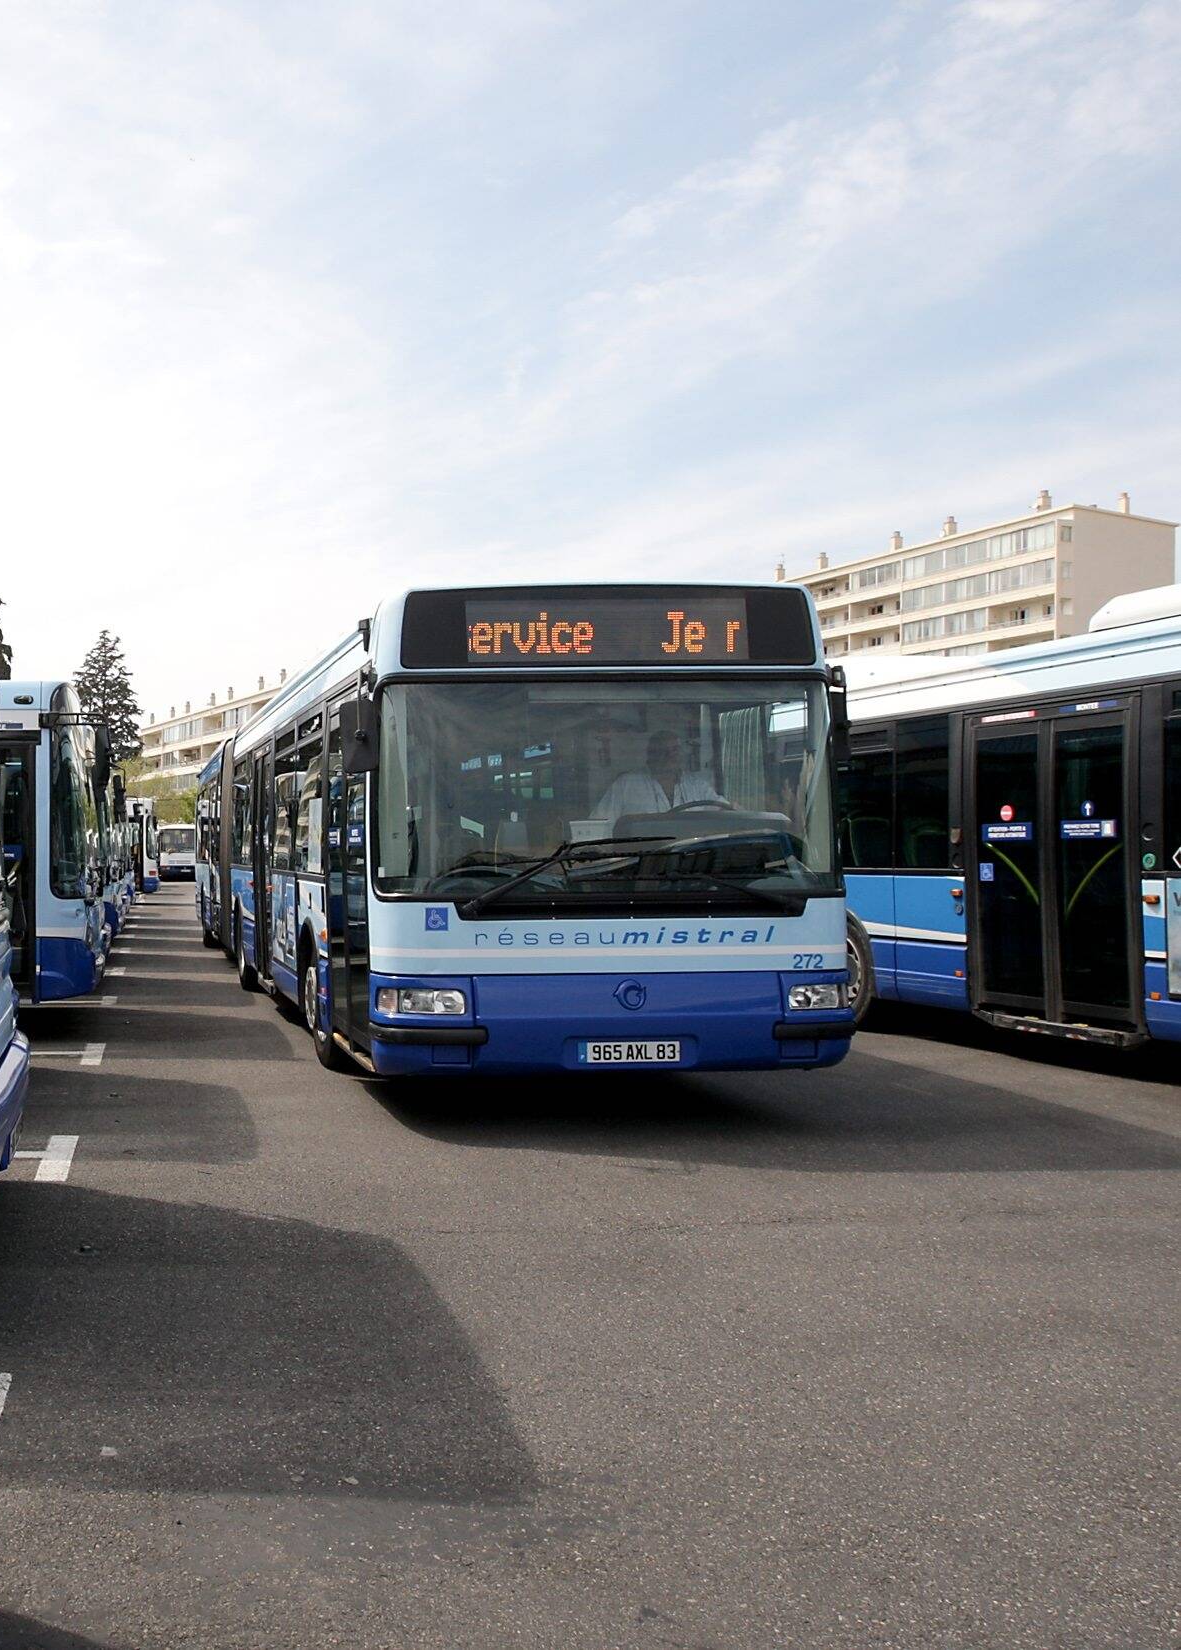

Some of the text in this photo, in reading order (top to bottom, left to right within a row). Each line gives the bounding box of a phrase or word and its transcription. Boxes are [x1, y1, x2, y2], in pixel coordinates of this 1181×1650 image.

[468, 611, 740, 654] ervice Je r
[474, 925, 775, 947] réseaumistral
[792, 953, 824, 969] 272
[592, 1045, 622, 1061] 965
[626, 1044, 653, 1060] AXL
[656, 1044, 676, 1060] 83
